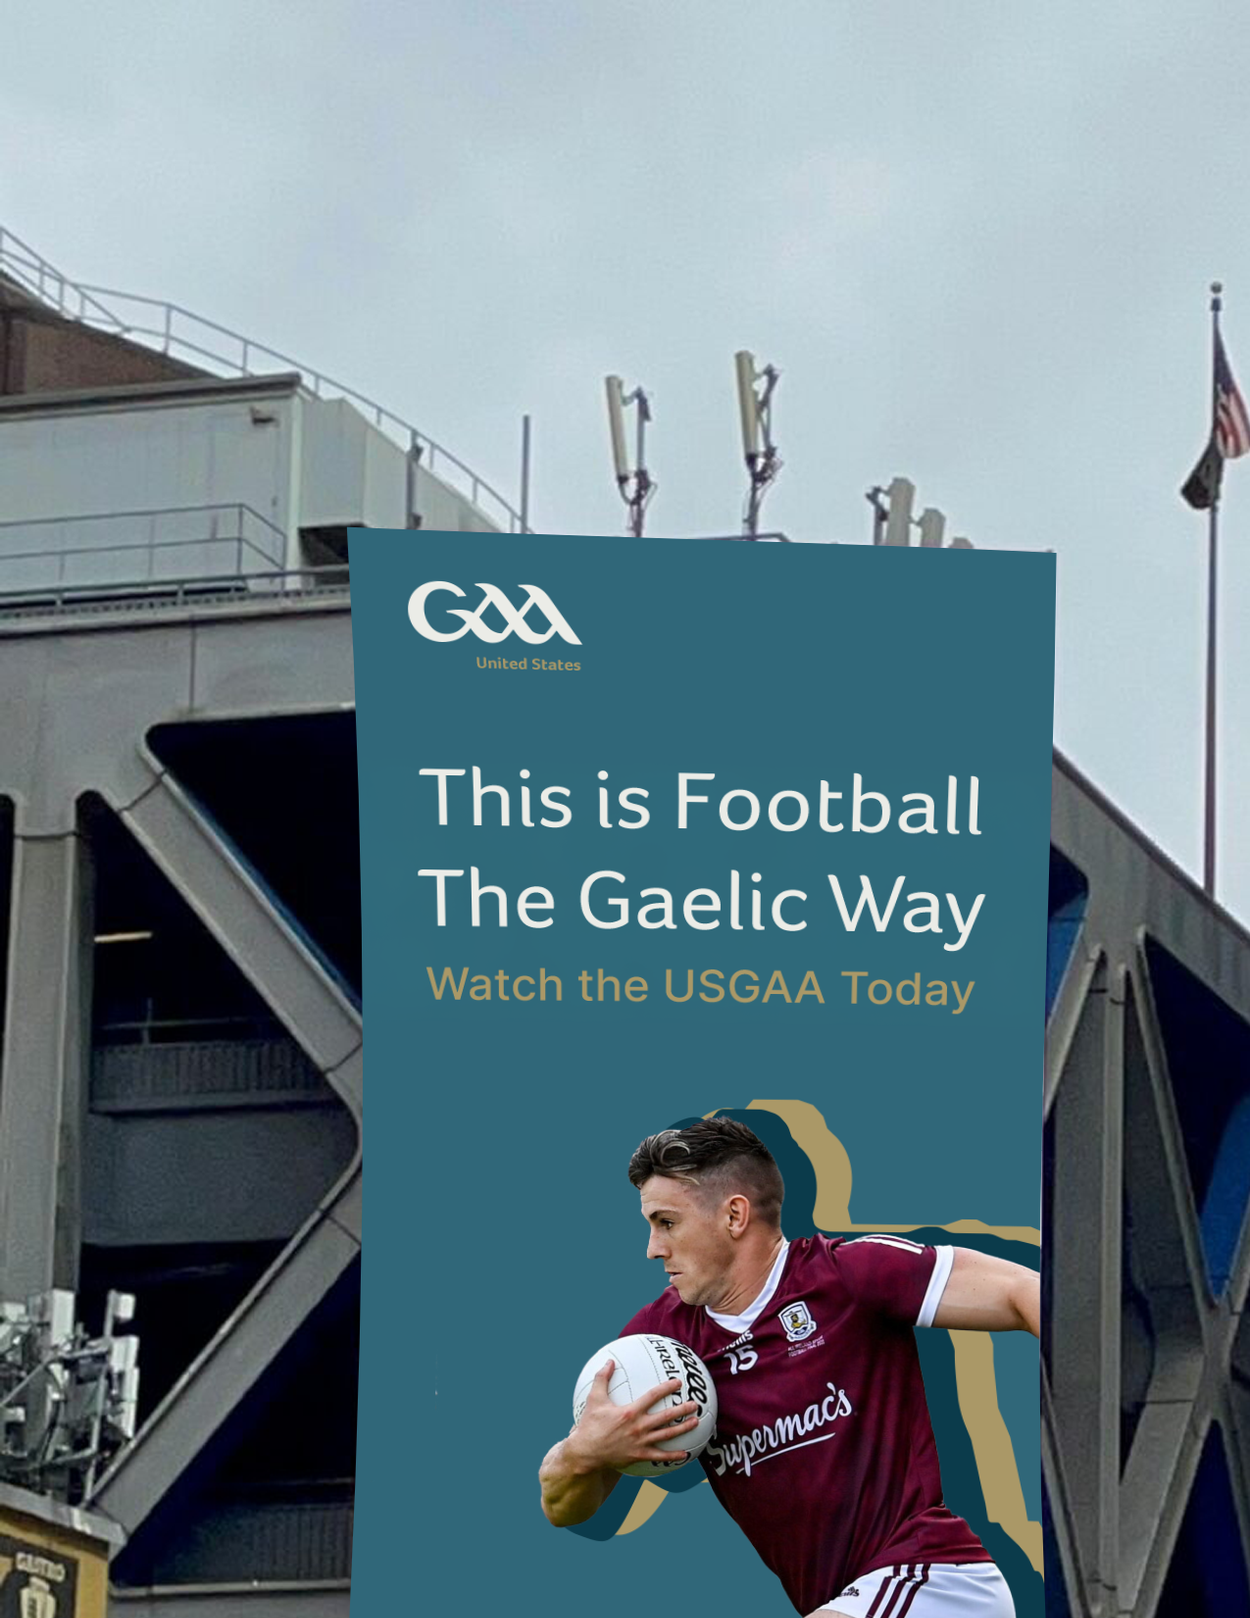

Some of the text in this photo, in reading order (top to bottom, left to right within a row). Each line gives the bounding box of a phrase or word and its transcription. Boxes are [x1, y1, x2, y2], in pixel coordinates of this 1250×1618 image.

[408, 581, 583, 645] GAA
[476, 657, 582, 672] United States
[419, 765, 982, 835] This is Football
[417, 866, 986, 952] The Gaelic Way
[426, 967, 976, 1014] Watch the USGAA Today
[723, 1344, 759, 1375] 15
[706, 1382, 853, 1477] Supermac's
